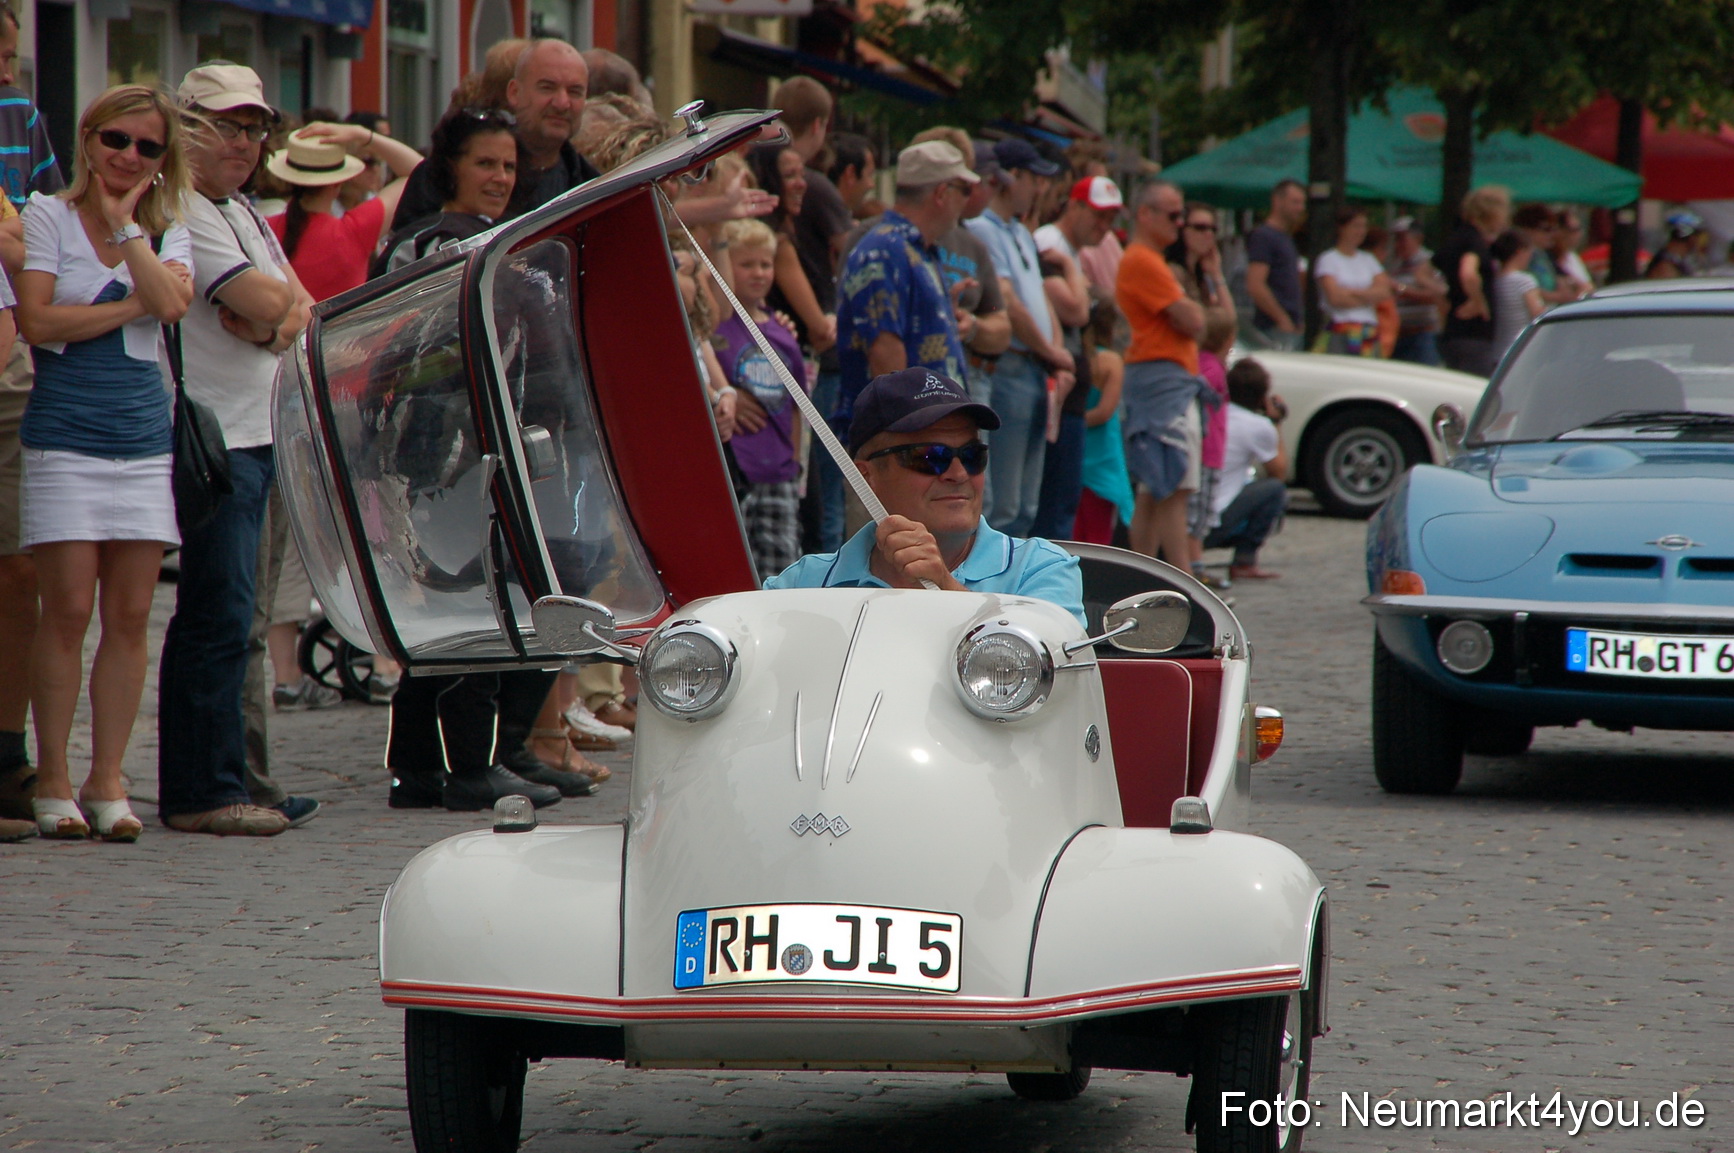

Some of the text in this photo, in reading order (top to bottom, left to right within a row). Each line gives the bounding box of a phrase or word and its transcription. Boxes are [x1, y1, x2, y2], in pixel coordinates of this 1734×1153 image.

[1589, 637, 1734, 672] RH GT 6
[795, 816, 845, 833] FMR
[709, 914, 952, 979] RH JI 5
[685, 957, 697, 974] D
